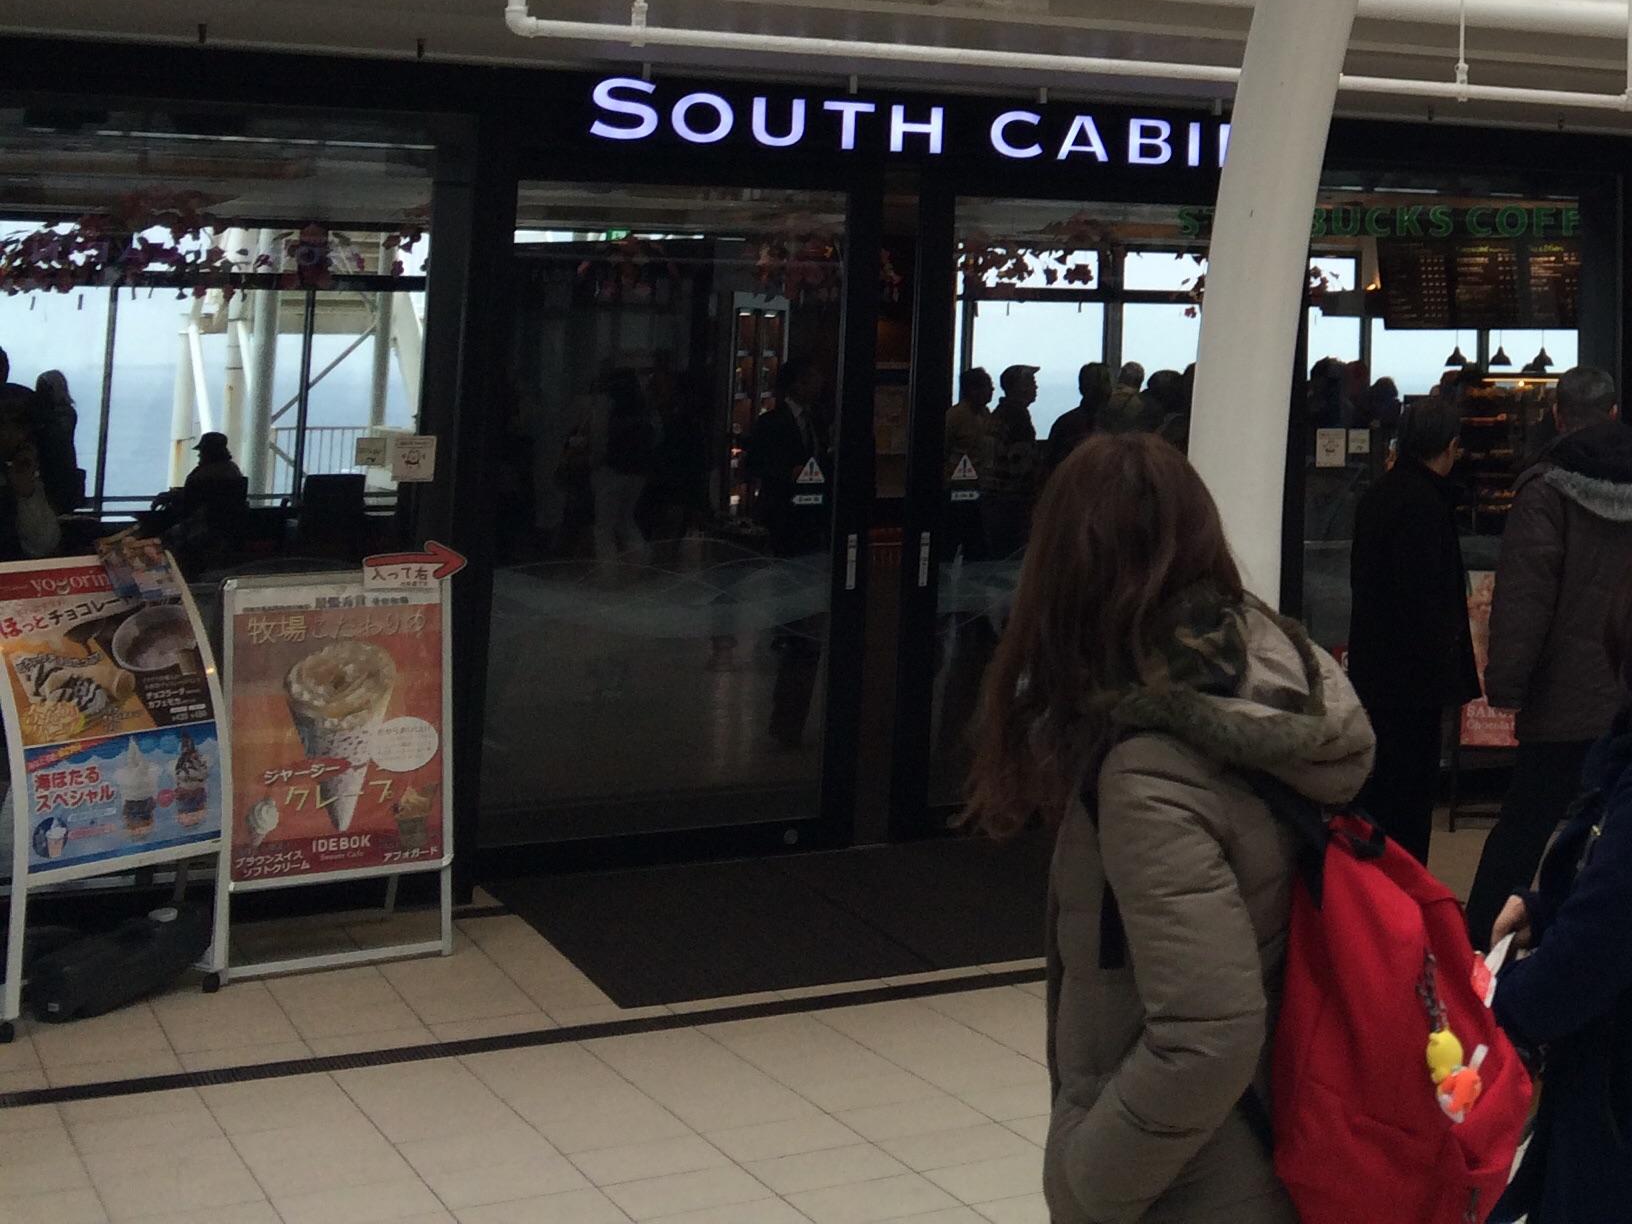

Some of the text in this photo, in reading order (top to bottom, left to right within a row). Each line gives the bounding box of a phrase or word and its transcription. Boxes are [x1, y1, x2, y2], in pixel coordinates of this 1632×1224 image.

[589, 77, 945, 155] SOUTH
[1176, 204, 1453, 238] SBUCKS
[30, 569, 110, 597] yogorin
[34, 765, 101, 792] 海ほたる
[36, 784, 115, 813] スペシャル
[284, 779, 394, 812] クレープ
[312, 834, 372, 853] IDEBOK
[243, 860, 311, 878] ソフトクリーム
